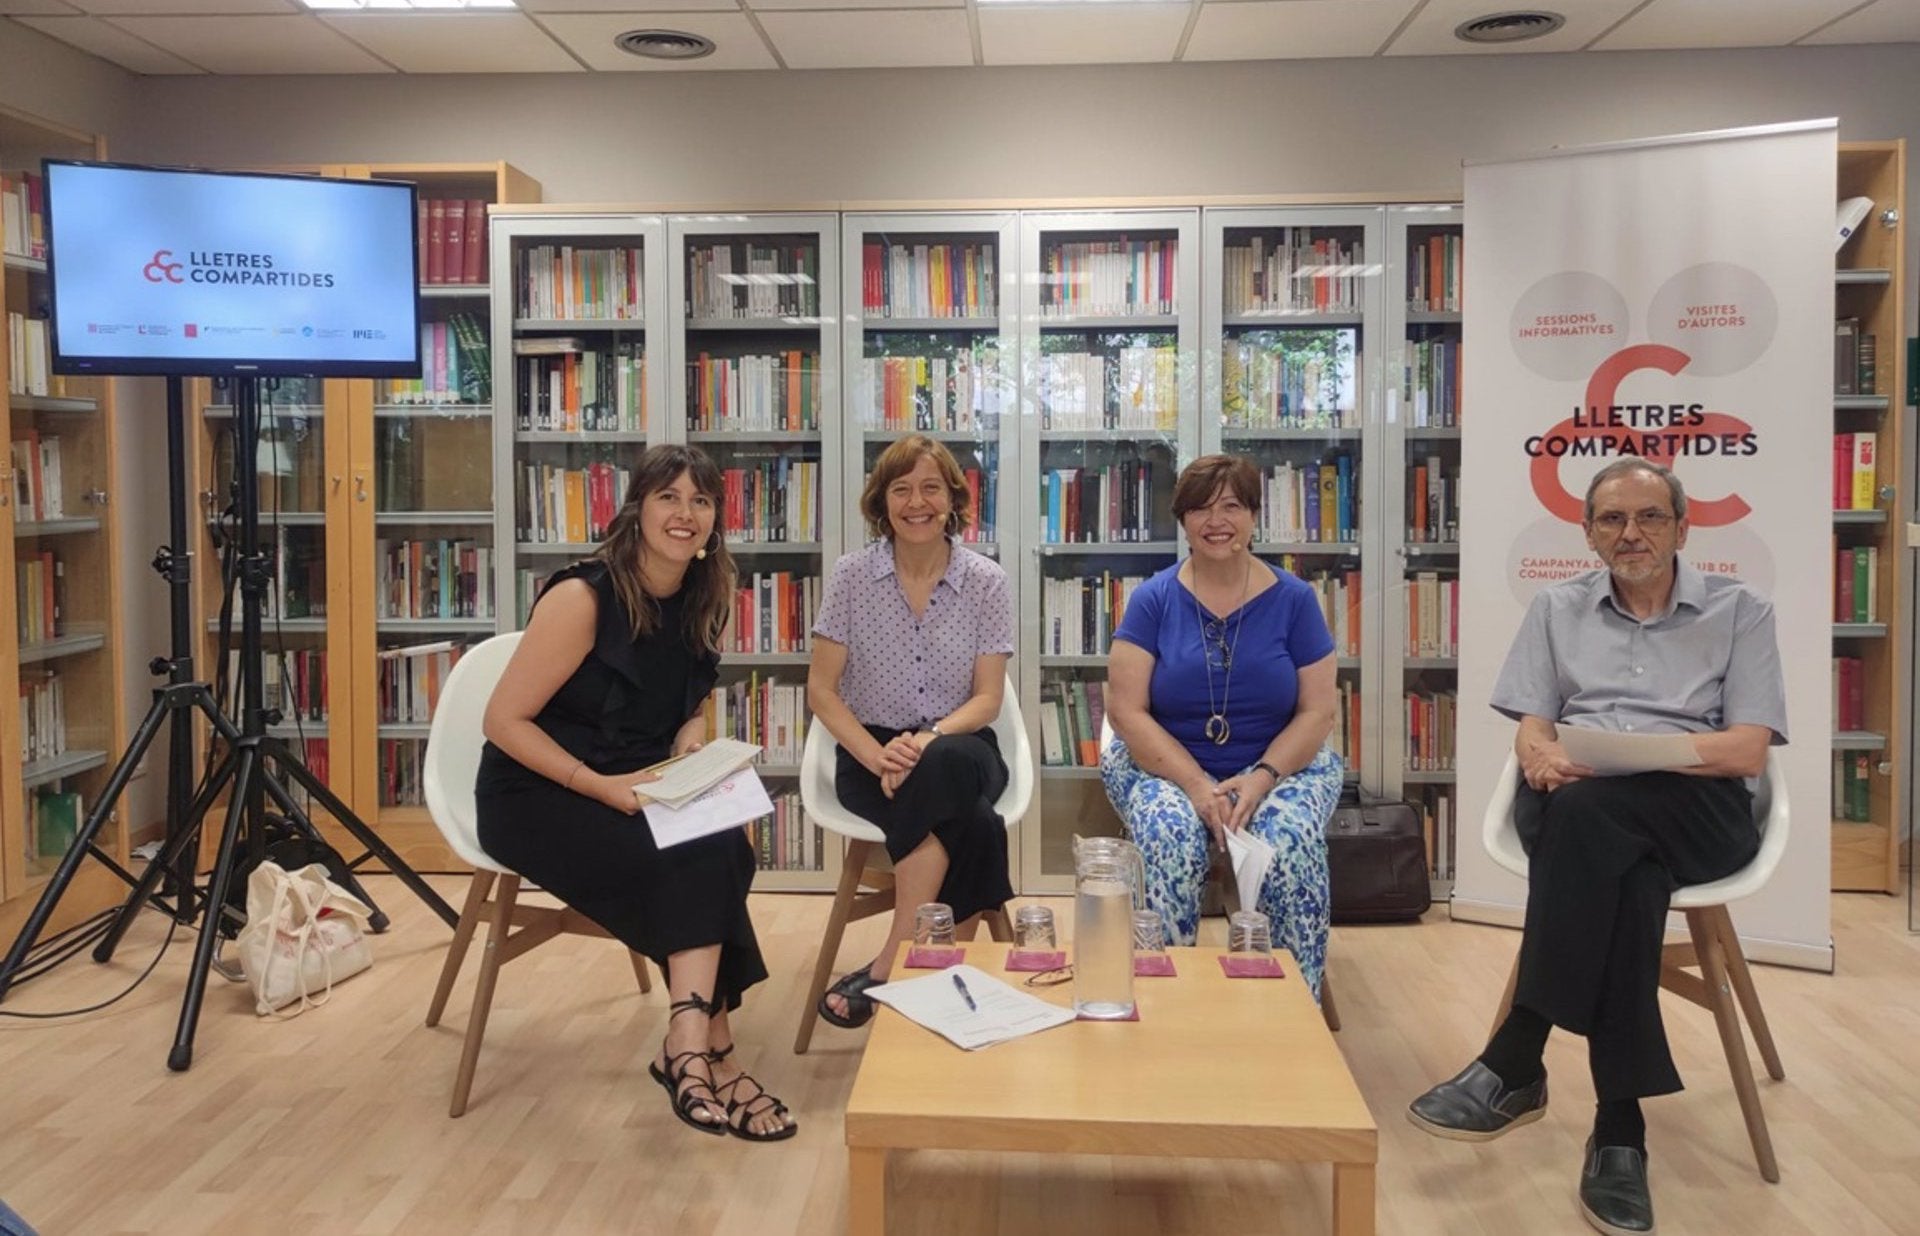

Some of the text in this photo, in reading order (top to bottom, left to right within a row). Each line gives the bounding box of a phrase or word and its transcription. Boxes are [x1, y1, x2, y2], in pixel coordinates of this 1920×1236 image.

[190, 252, 273, 269] LLETRES
[190, 269, 334, 288] COMPARTIDES
[1686, 304, 1737, 316] VISITES
[1535, 313, 1597, 326] SESSIONS
[1678, 316, 1746, 329] D'AUTORS
[1519, 324, 1615, 337] INFORMATIVES
[1573, 404, 1705, 428] LLETRES
[1523, 432, 1759, 458] COMPARTIDES
[1521, 558, 1604, 569] CAMPANYA D
[1720, 562, 1738, 573] DE
